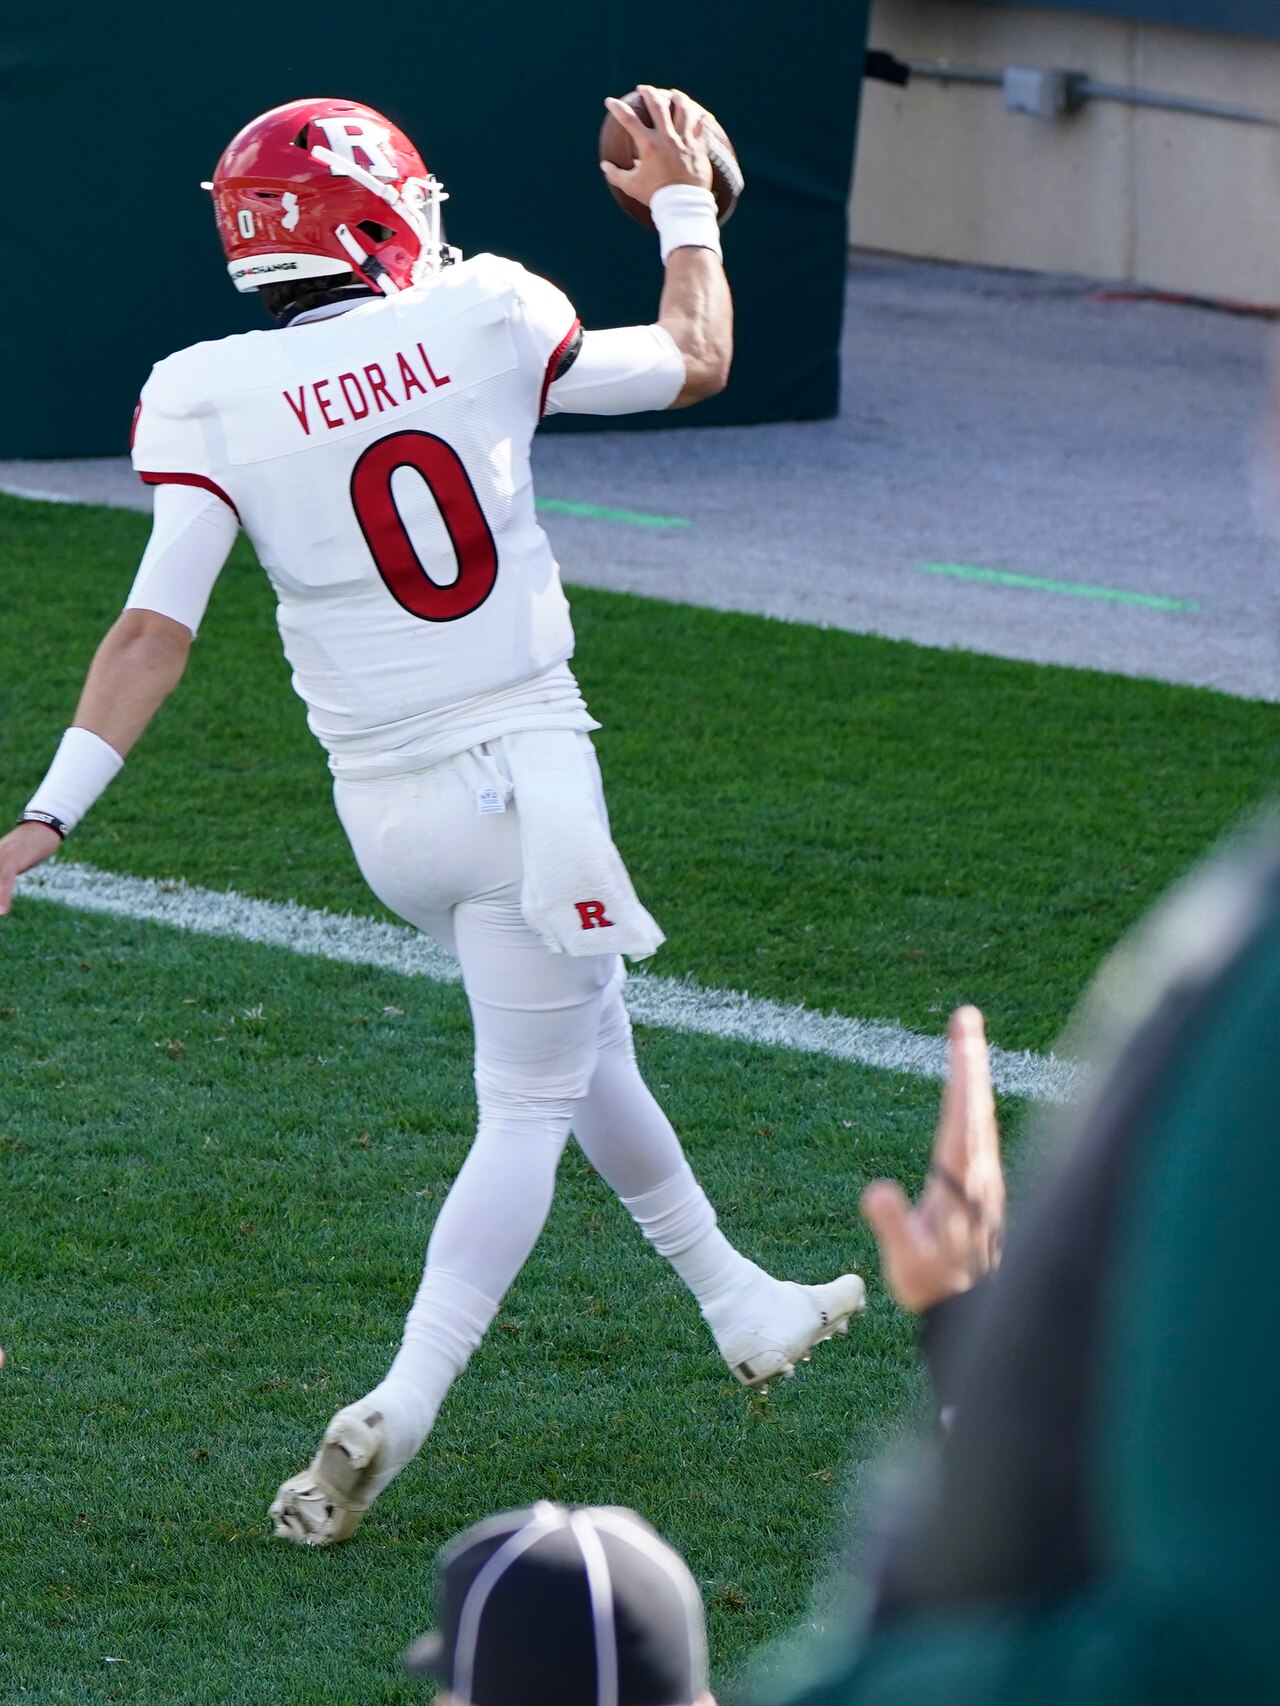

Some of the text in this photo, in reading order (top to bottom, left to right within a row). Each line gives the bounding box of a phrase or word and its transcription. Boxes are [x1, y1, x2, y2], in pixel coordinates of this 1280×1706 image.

[313, 117, 400, 180] R
[237, 209, 255, 239] 0
[282, 342, 451, 436] VEDRAL
[350, 429, 498, 622] 0
[575, 900, 615, 930] R
